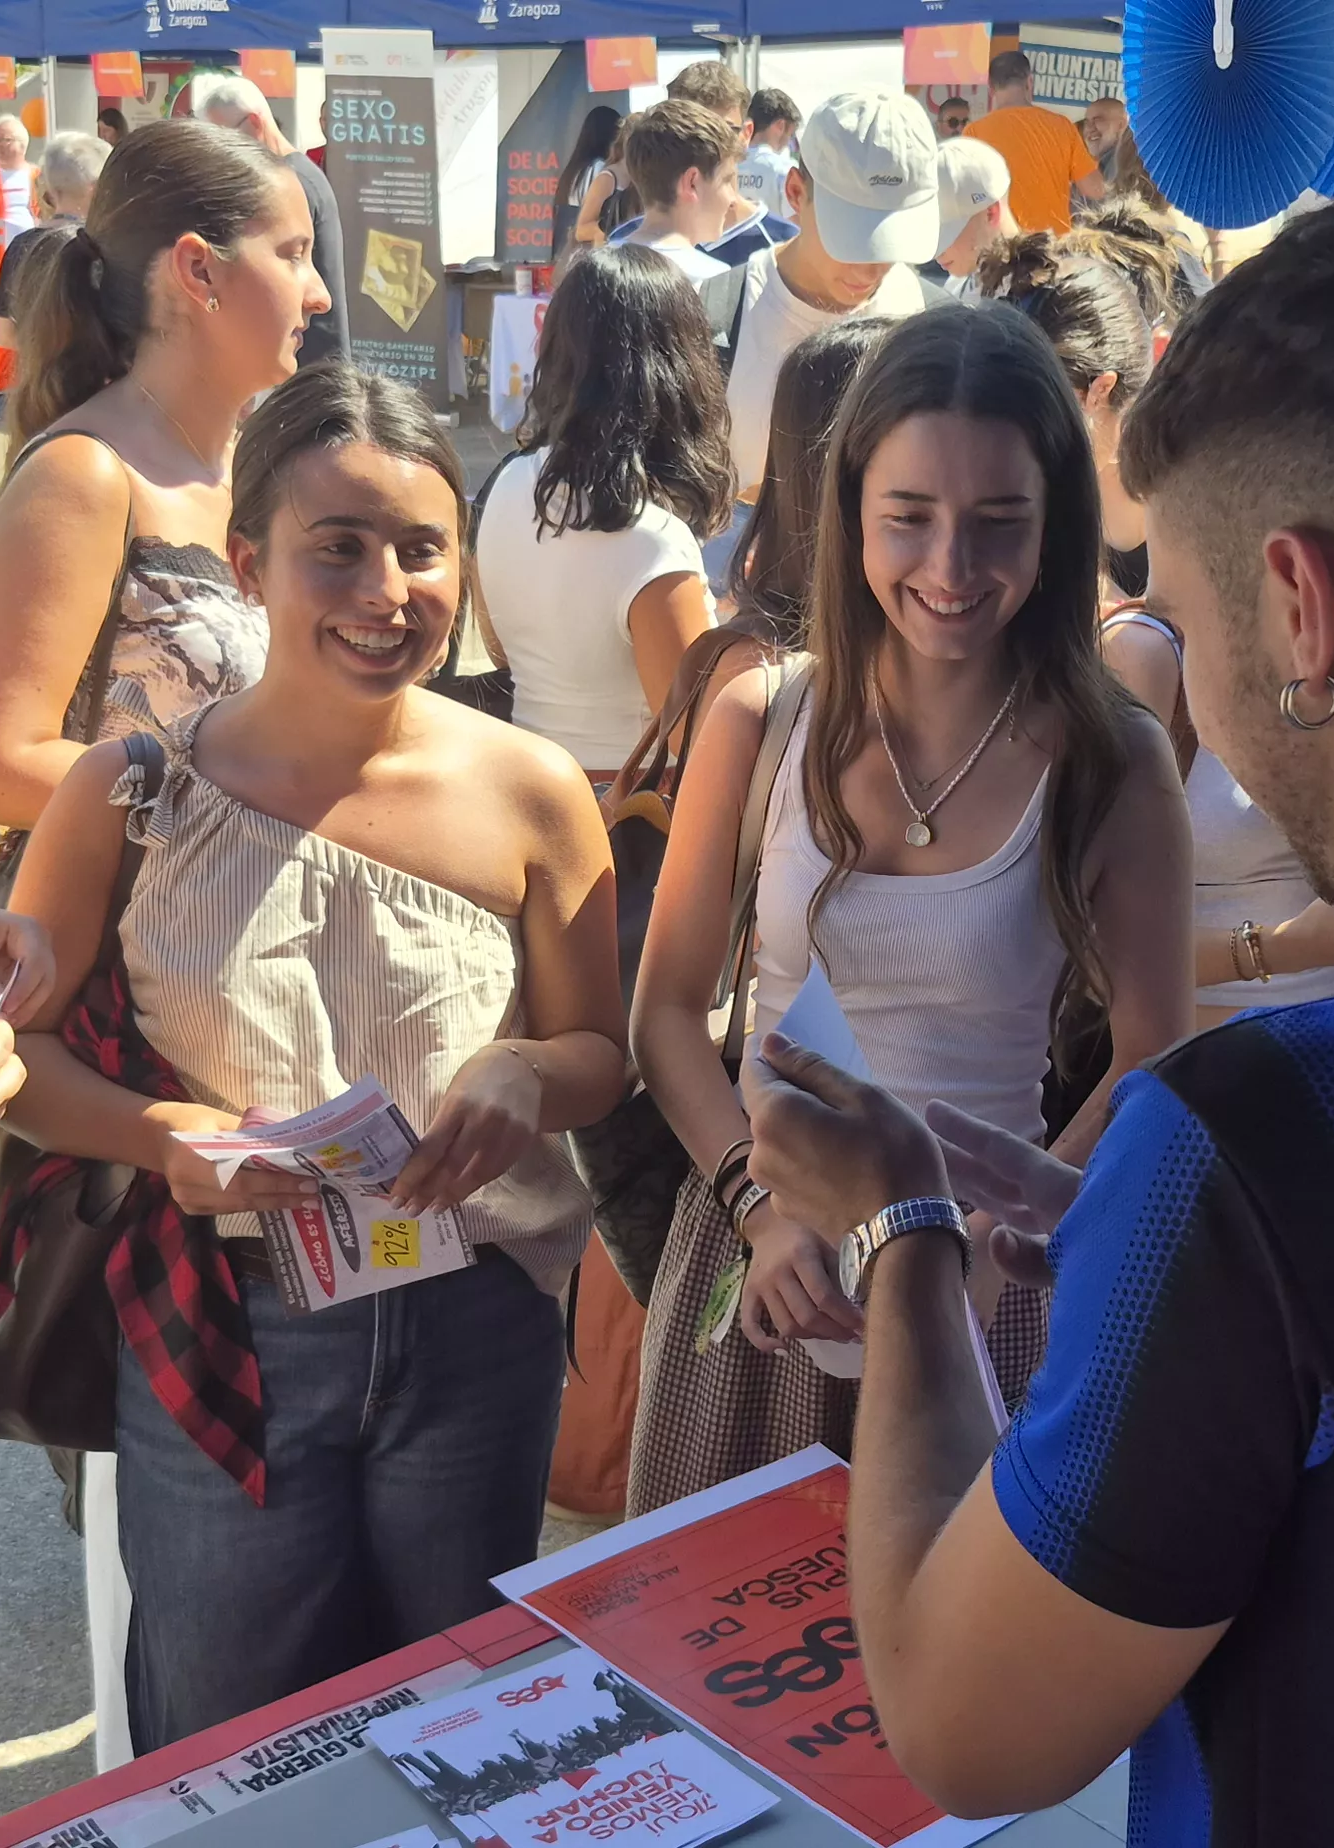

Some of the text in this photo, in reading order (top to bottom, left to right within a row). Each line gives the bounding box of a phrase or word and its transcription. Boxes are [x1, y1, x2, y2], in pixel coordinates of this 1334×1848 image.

[169, 14, 208, 30] Zaragoza
[508, 4, 561, 19] Zaragoza
[331, 99, 396, 120] SEXO
[331, 123, 427, 146] GRATIS
[508, 150, 560, 170] DE LA
[507, 202, 554, 221] PARA
[506, 228, 554, 247] SOCI
[307, 1223, 319, 1237] ES
[383, 1222, 411, 1267] 92%
[313, 1240, 332, 1283] ¿CÓMO
[639, 1565, 680, 1587] AULA
[712, 1534, 848, 1608] UESCA
[680, 1567, 848, 1651] PUS DE
[240, 1687, 425, 1770] IMPERIALISTA
[785, 1704, 881, 1759] ÓN
[239, 1739, 349, 1793] GUERRA
[524, 1759, 668, 1828] LUCHAR.
[531, 1774, 689, 1844] VENIDO A
[589, 1782, 703, 1840] HEMOS
